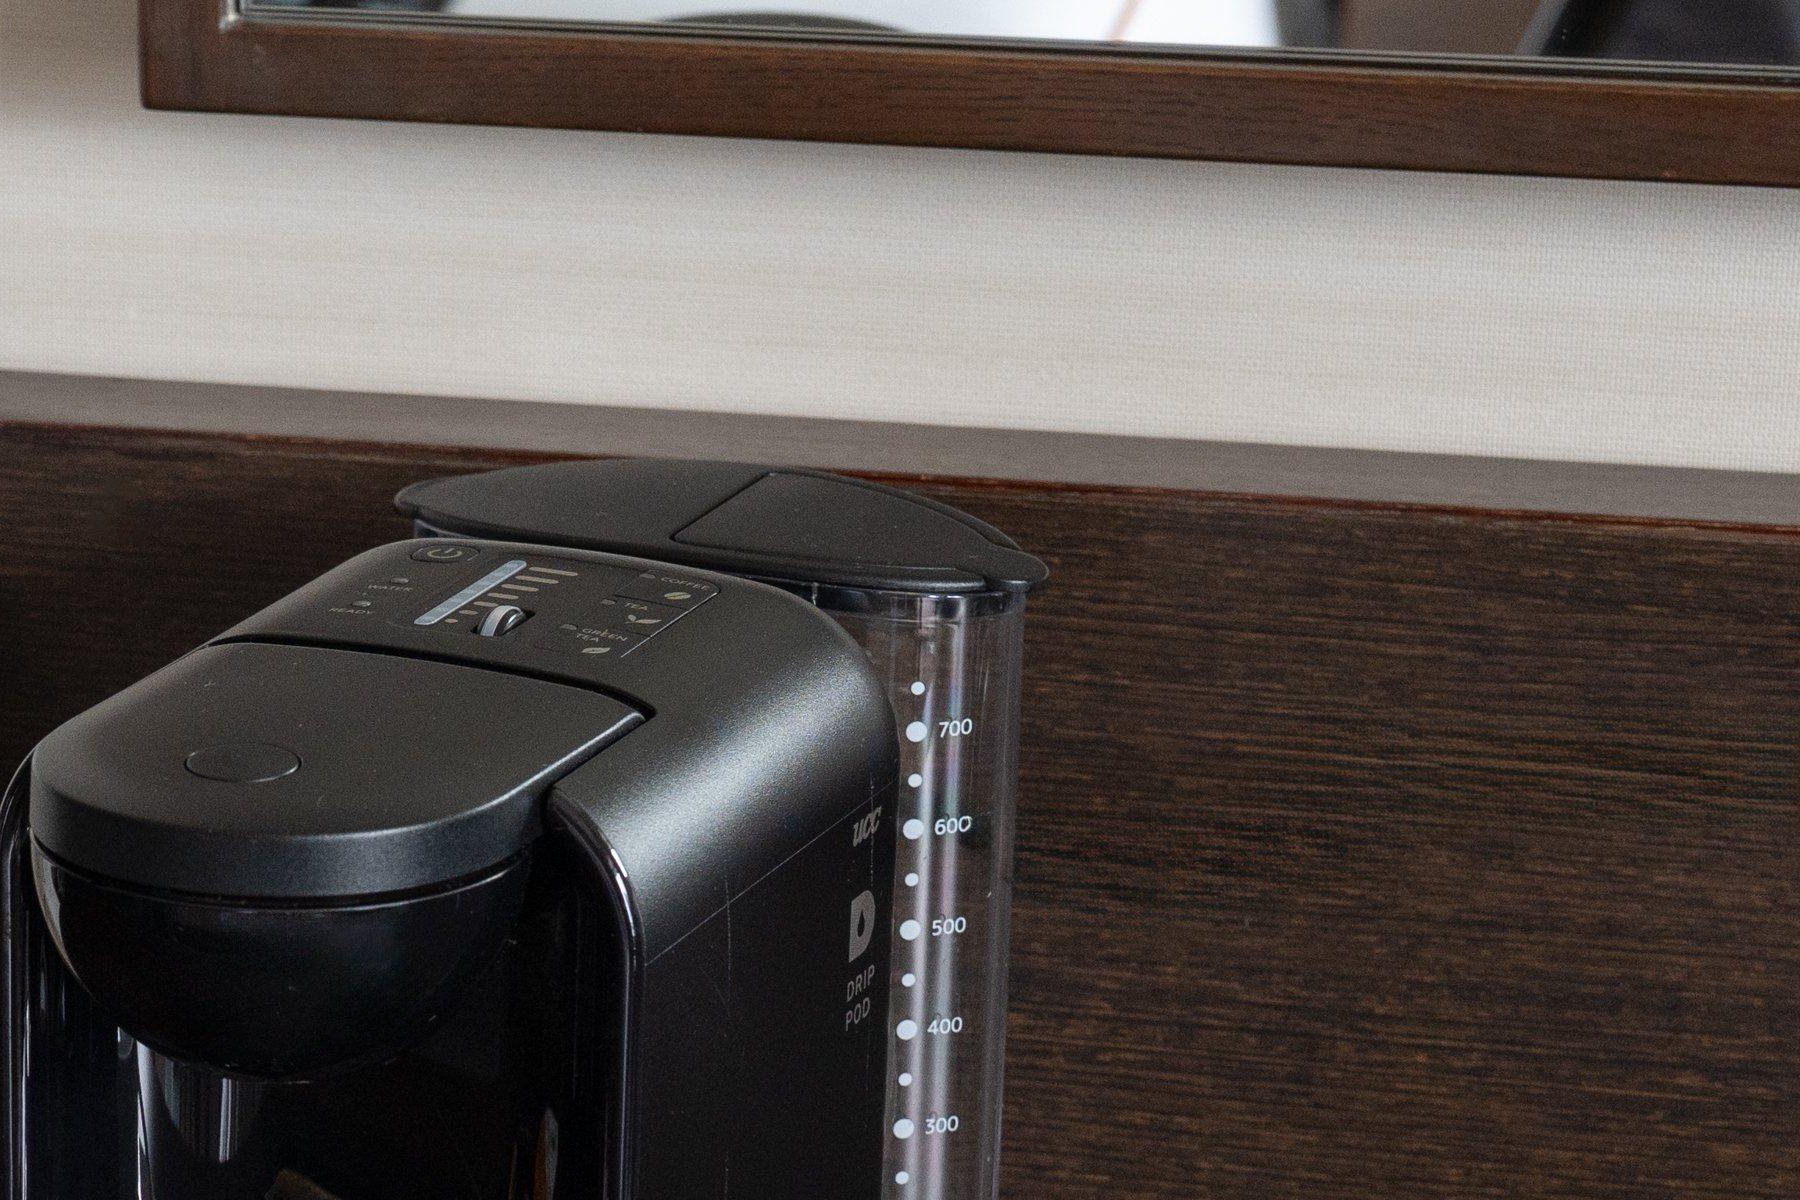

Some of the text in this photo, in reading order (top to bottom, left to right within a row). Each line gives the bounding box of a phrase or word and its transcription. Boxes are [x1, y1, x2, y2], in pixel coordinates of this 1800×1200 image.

[938, 718, 973, 738] 700
[934, 815, 973, 836] 600
[931, 917, 966, 937] 500
[846, 964, 874, 1003] DRIP
[845, 997, 871, 1032] POD
[927, 1016, 963, 1036] 400
[925, 1115, 959, 1135] 300
